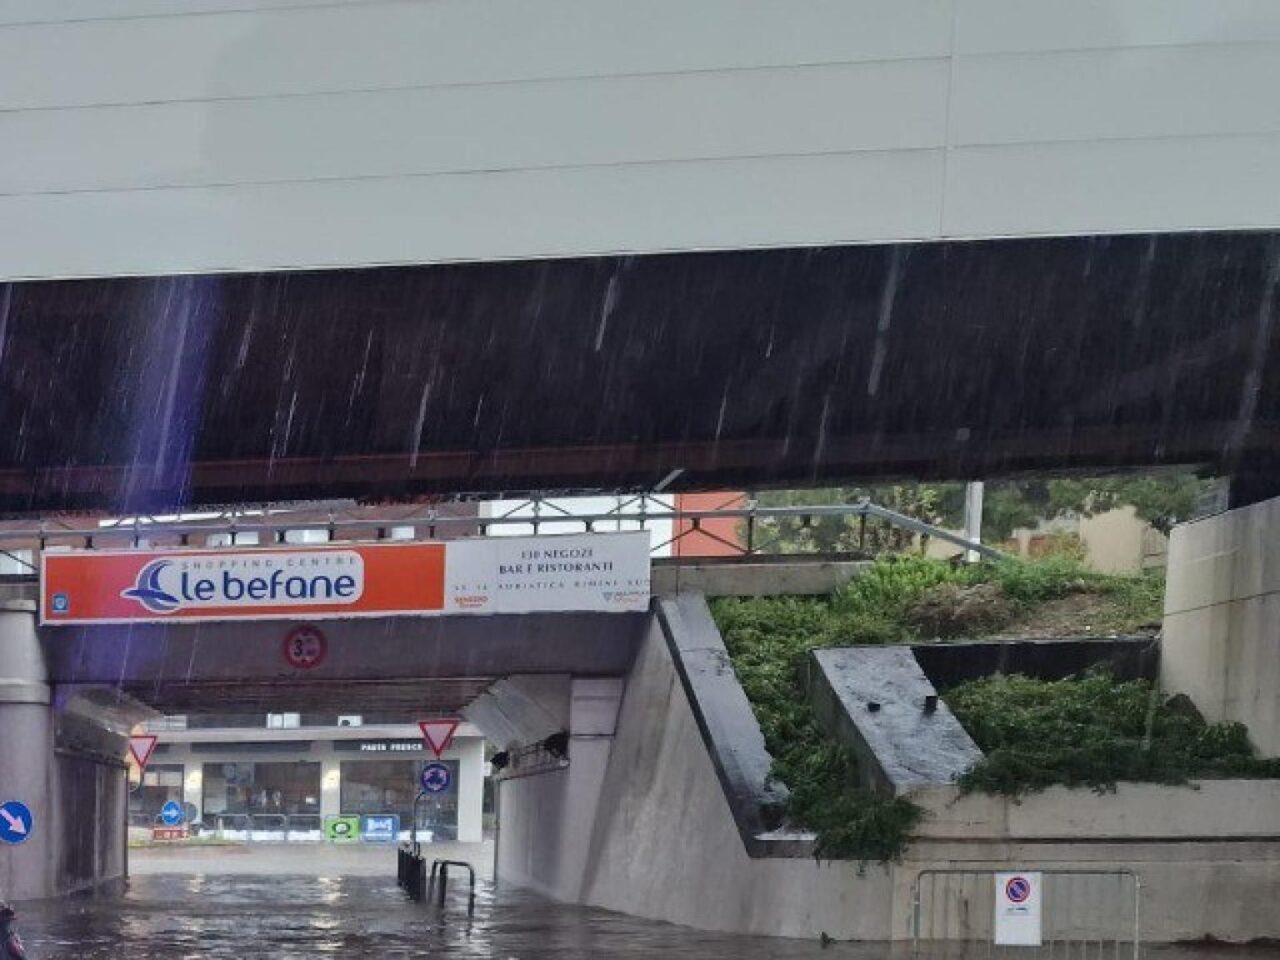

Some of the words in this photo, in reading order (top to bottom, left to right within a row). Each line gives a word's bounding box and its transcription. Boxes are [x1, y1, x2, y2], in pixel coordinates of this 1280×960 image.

[544, 547, 593, 559] NEGOZI
[182, 559, 273, 570] SHOPPING
[287, 556, 355, 567] CENTRE
[499, 564, 523, 574] BAR
[537, 561, 613, 573] RISTORANTI
[181, 571, 215, 601] le
[223, 569, 355, 600] befane
